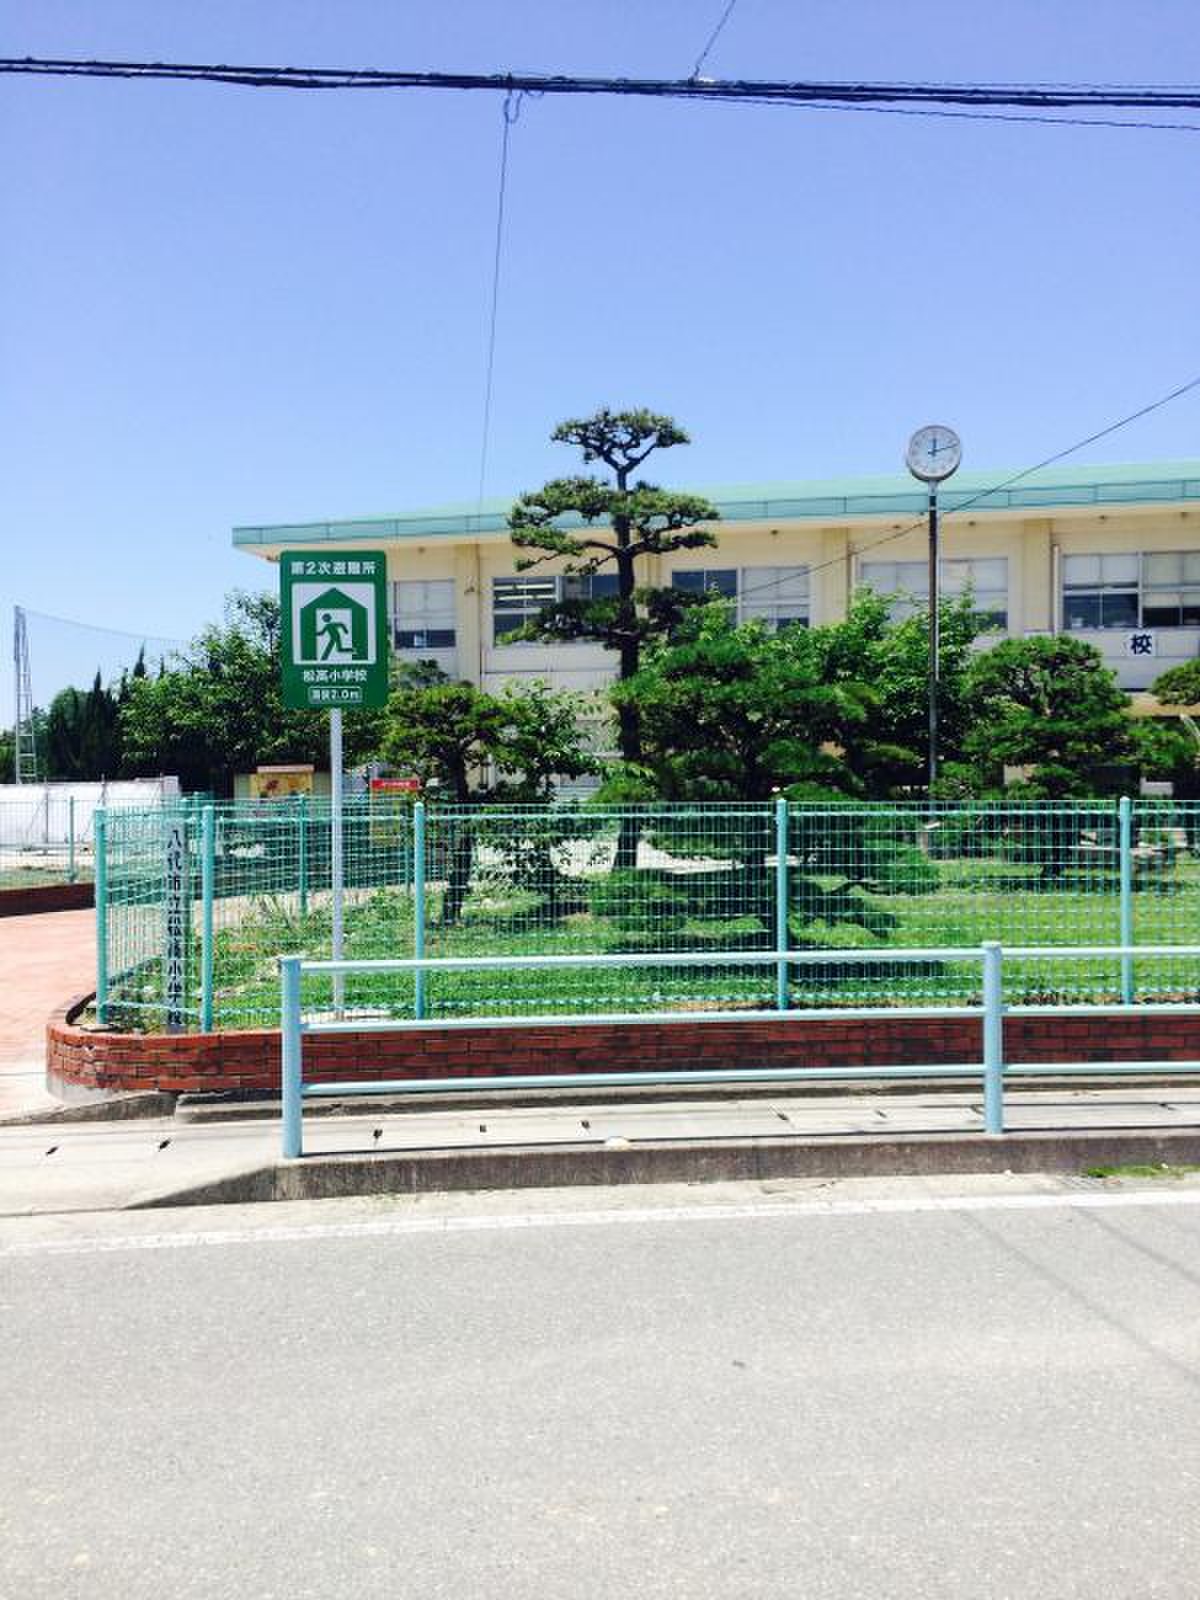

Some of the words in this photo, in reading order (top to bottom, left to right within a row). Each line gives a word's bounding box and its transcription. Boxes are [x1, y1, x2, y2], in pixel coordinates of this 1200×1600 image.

[291, 561, 376, 575] 第2次避難所
[1130, 634, 1153, 655] 校
[303, 668, 368, 682] 松高小学校
